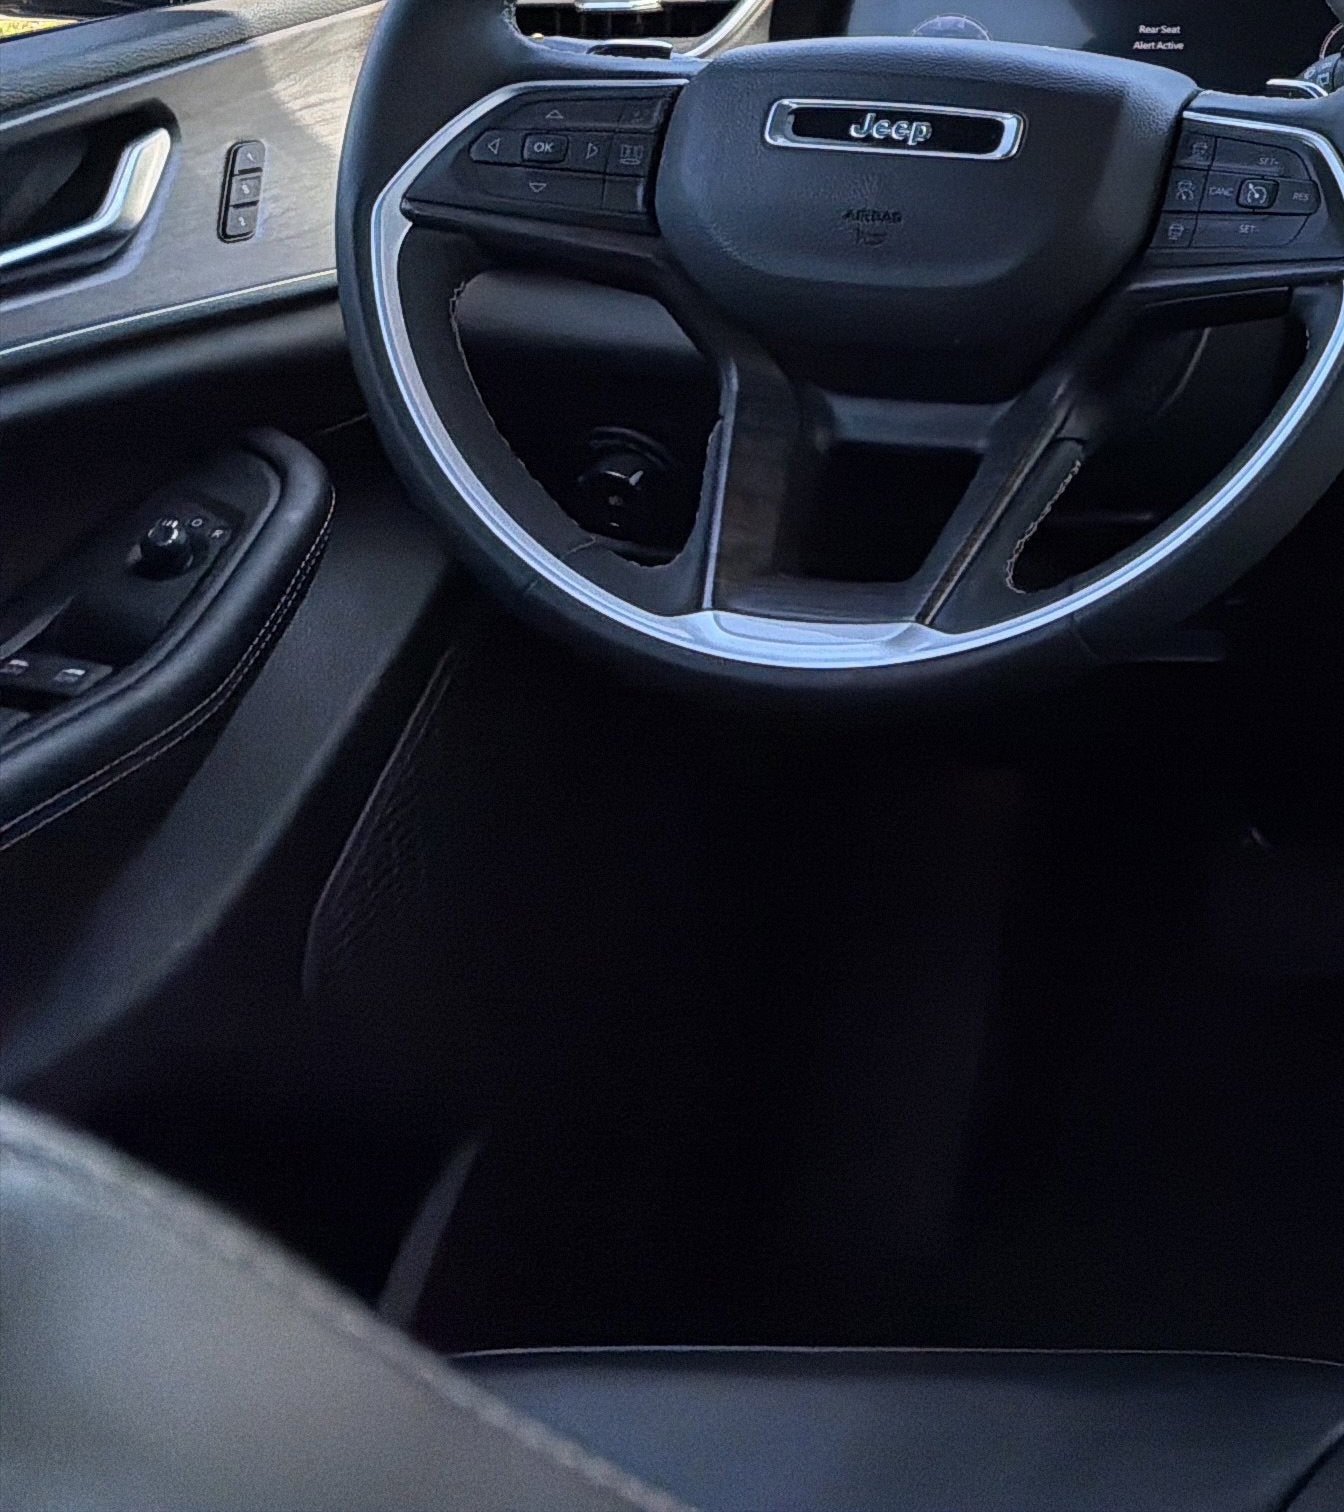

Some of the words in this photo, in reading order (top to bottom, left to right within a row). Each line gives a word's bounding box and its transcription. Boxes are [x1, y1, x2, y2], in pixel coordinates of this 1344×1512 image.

[1138, 24, 1160, 34] Rear
[1160, 24, 1181, 34] Seat
[1132, 40, 1156, 50] Alert
[1156, 40, 1184, 50] Active
[849, 112, 933, 146] Jeep
[533, 142, 555, 154] OK
[1292, 192, 1310, 202] RES
